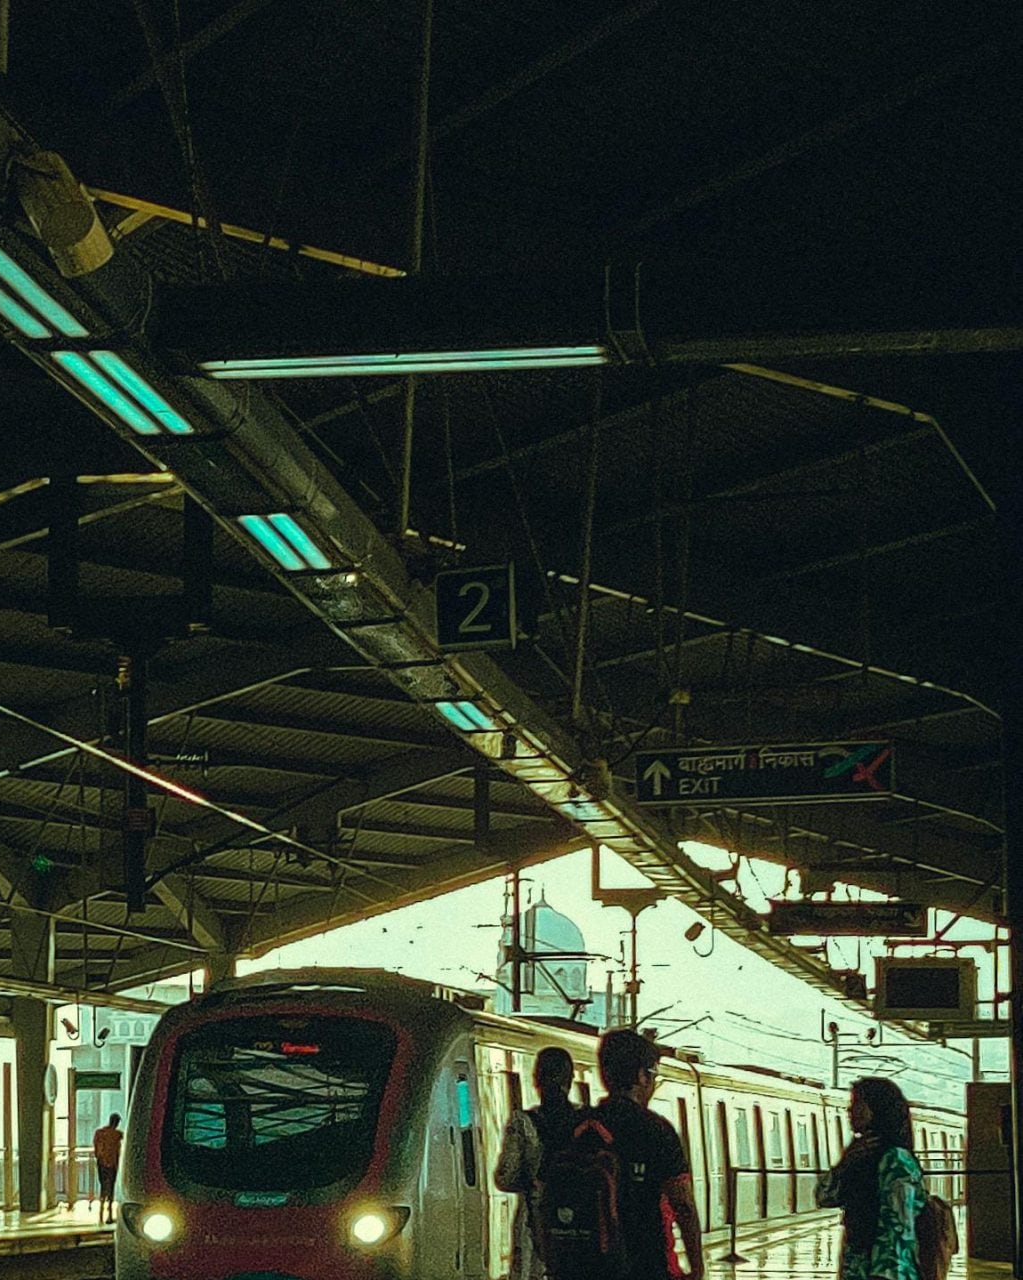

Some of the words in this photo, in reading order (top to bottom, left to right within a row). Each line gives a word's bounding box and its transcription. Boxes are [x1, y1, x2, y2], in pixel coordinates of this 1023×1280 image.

[458, 581, 493, 633] 2
[758, 747, 816, 769] निकास
[678, 776, 722, 795] EXIT
